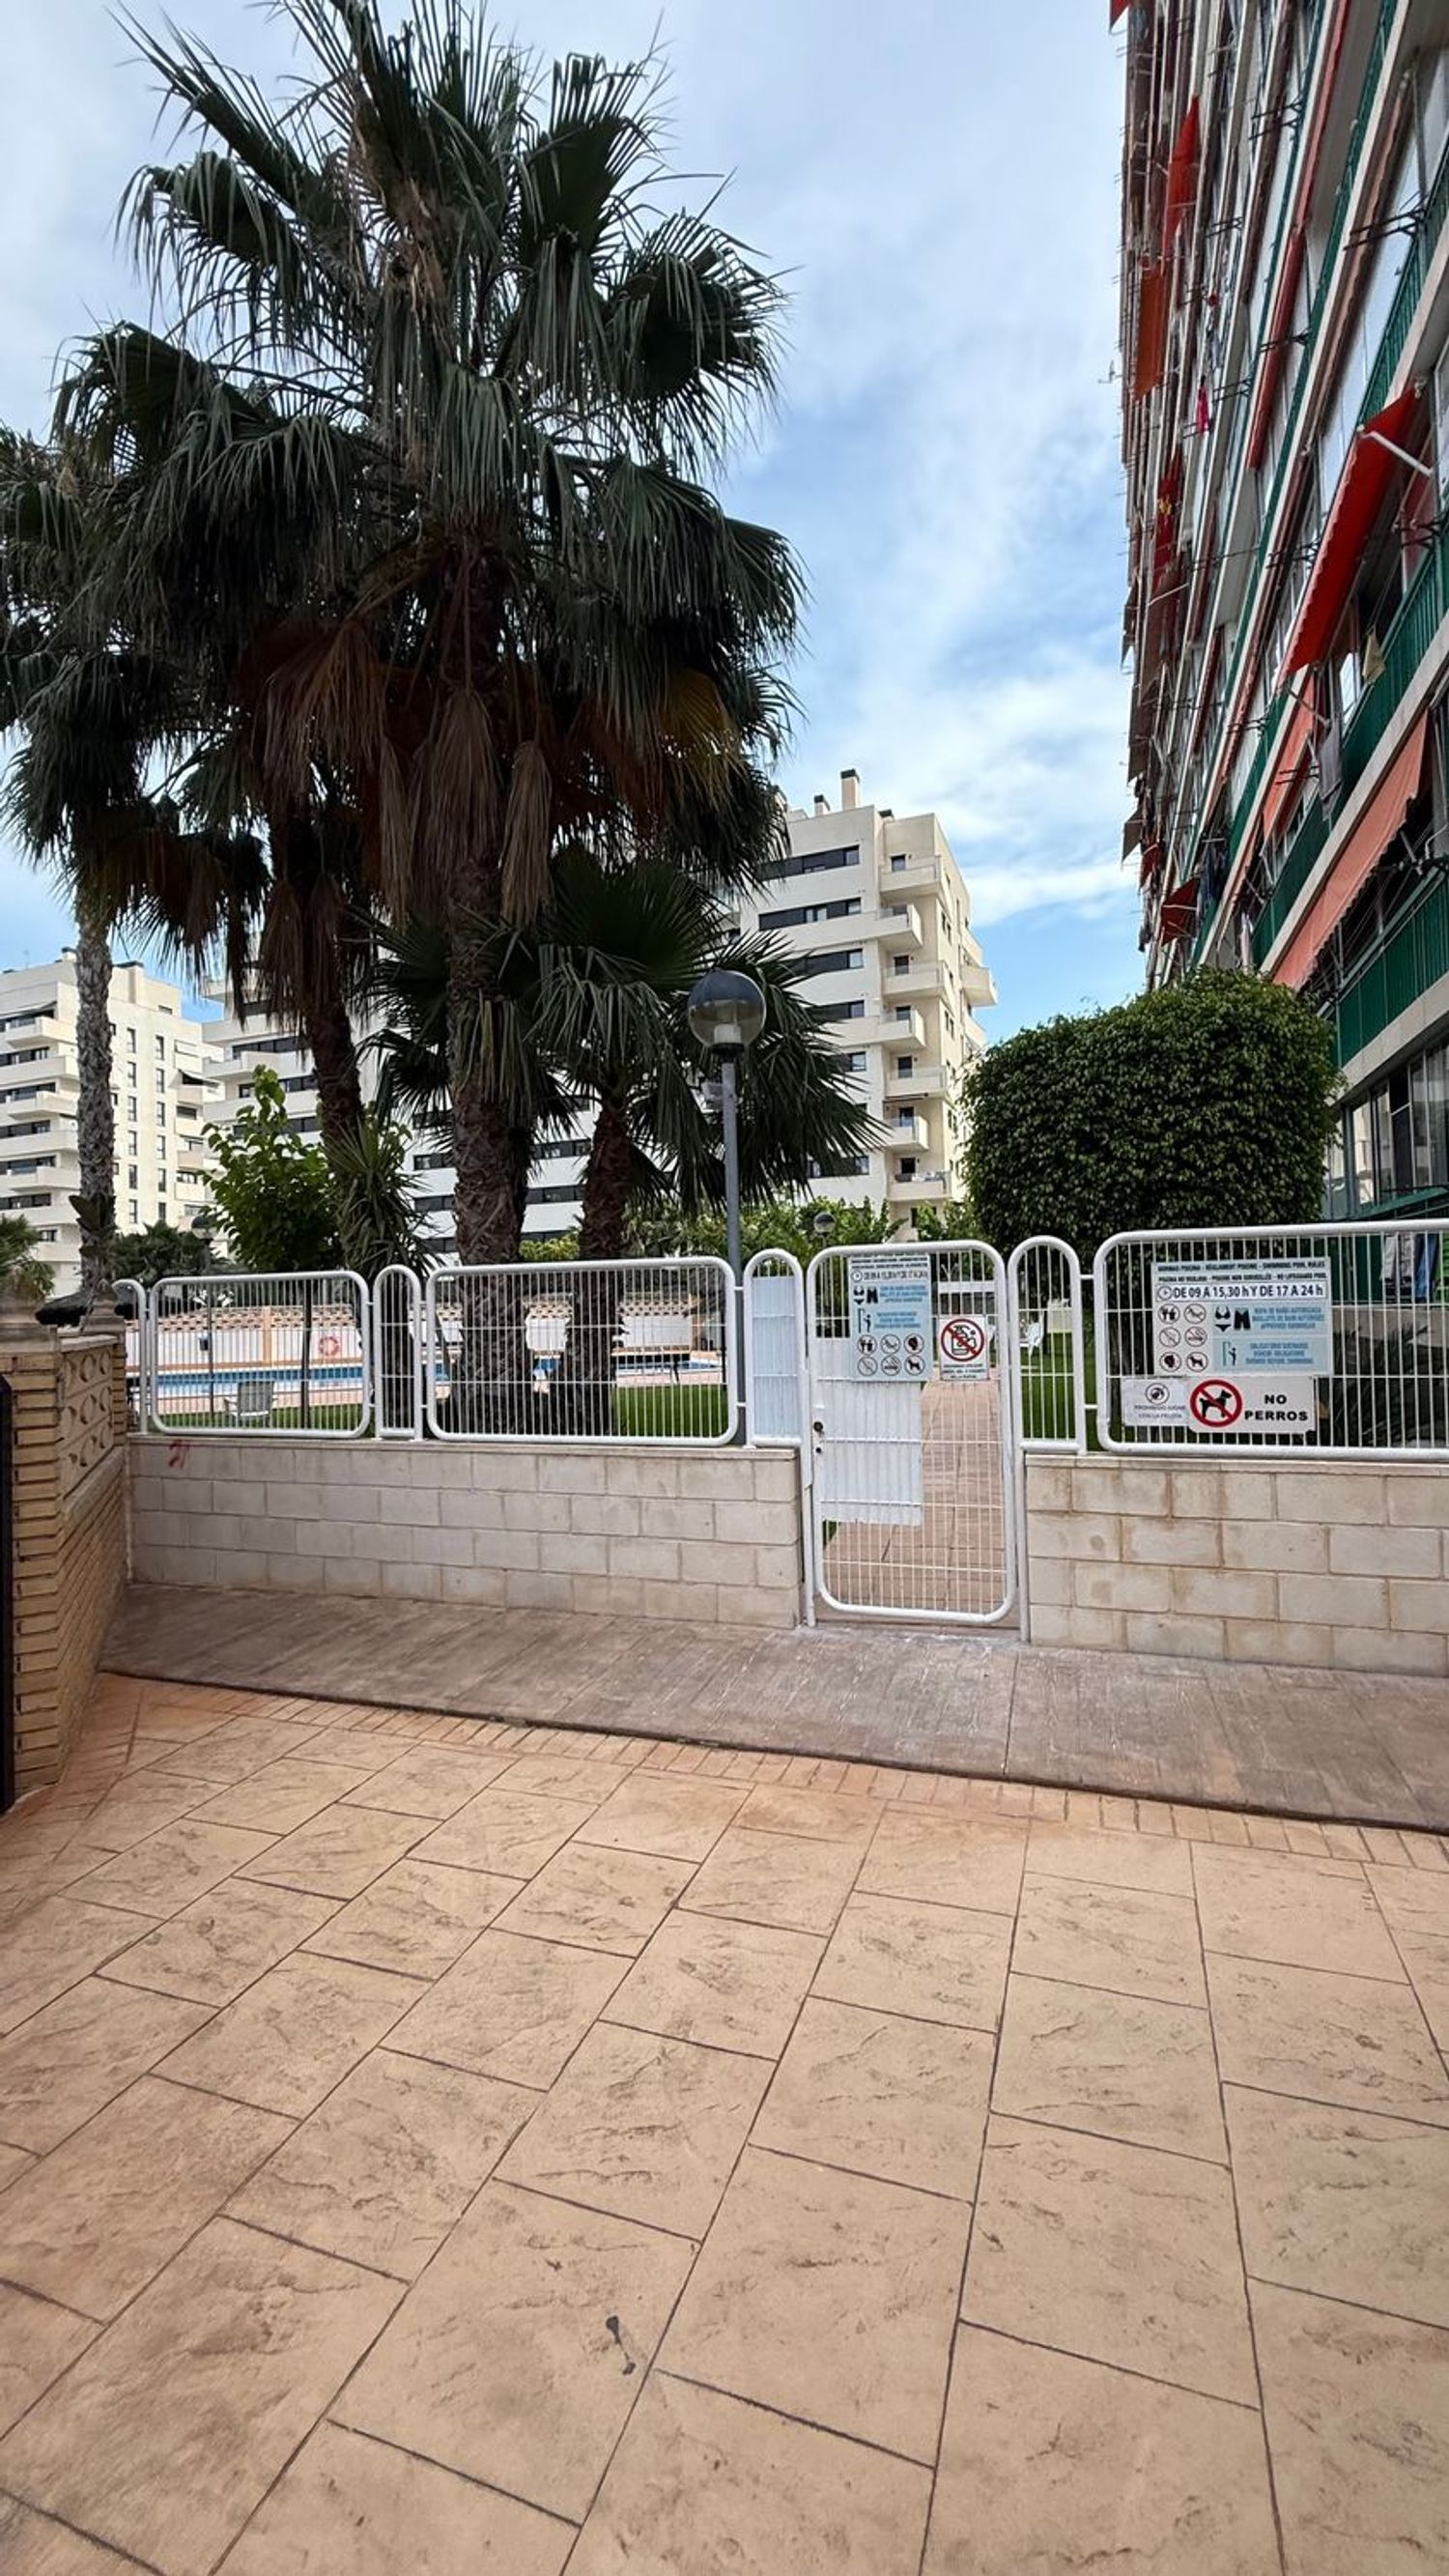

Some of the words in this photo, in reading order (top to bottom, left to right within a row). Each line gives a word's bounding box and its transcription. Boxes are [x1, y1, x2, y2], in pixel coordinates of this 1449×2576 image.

[1173, 1286, 1187, 1299] DE
[1188, 1286, 1201, 1298] 09
[1204, 1286, 1210, 1298] A
[1212, 1286, 1240, 1300] 15,30
[1260, 1285, 1273, 1297] DE
[1276, 1285, 1289, 1297] 17
[1292, 1284, 1298, 1297] A
[1301, 1284, 1314, 1297] 24
[1316, 1284, 1322, 1296] h
[1264, 1394, 1287, 1405] NO
[1244, 1410, 1309, 1421] PERROS
